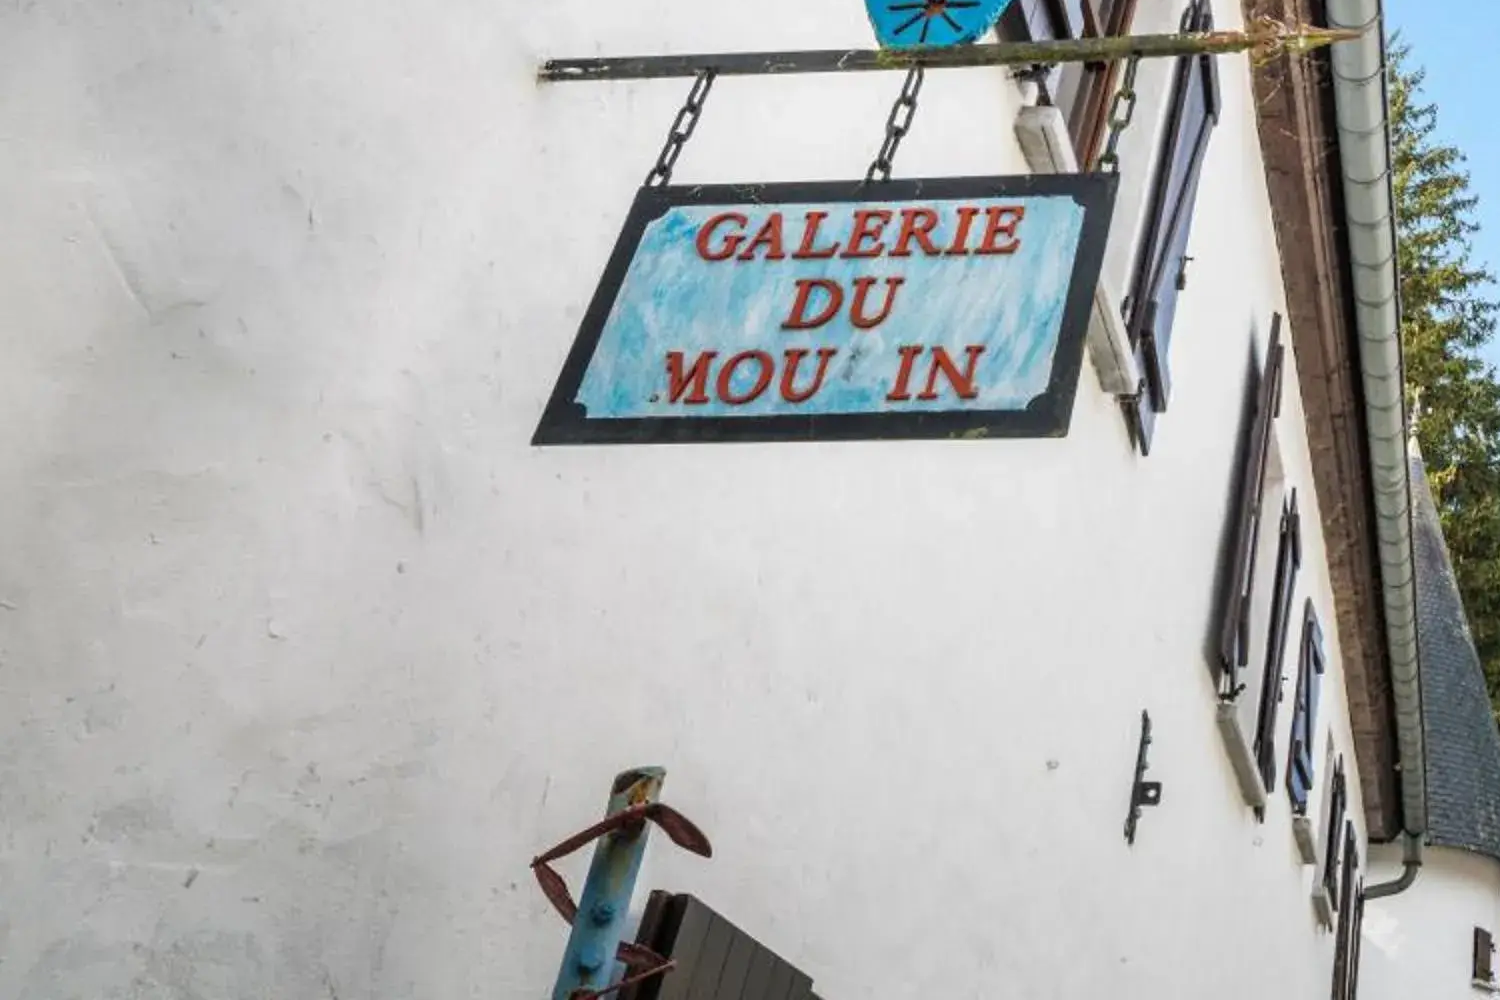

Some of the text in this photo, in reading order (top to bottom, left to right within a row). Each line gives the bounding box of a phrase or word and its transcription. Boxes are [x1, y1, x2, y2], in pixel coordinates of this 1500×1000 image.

[696, 204, 1025, 260] GALERIE
[782, 277, 904, 330] DU
[664, 345, 985, 405] MOUIN
